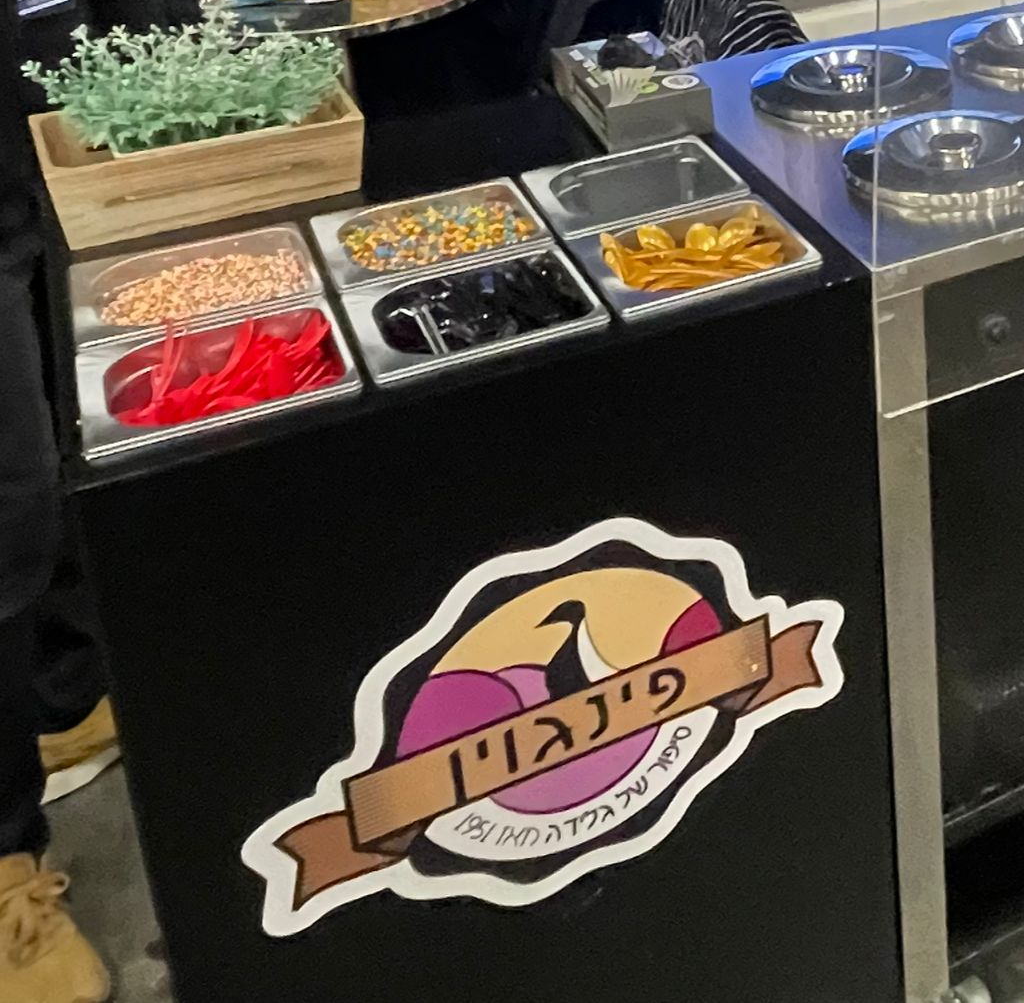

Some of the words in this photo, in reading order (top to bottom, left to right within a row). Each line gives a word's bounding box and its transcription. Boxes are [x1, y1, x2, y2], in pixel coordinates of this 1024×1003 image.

[448, 666, 687, 806] פינגוין
[615, 775, 649, 809] של
[453, 812, 497, 843] 1951
[545, 804, 616, 845] גלידה
